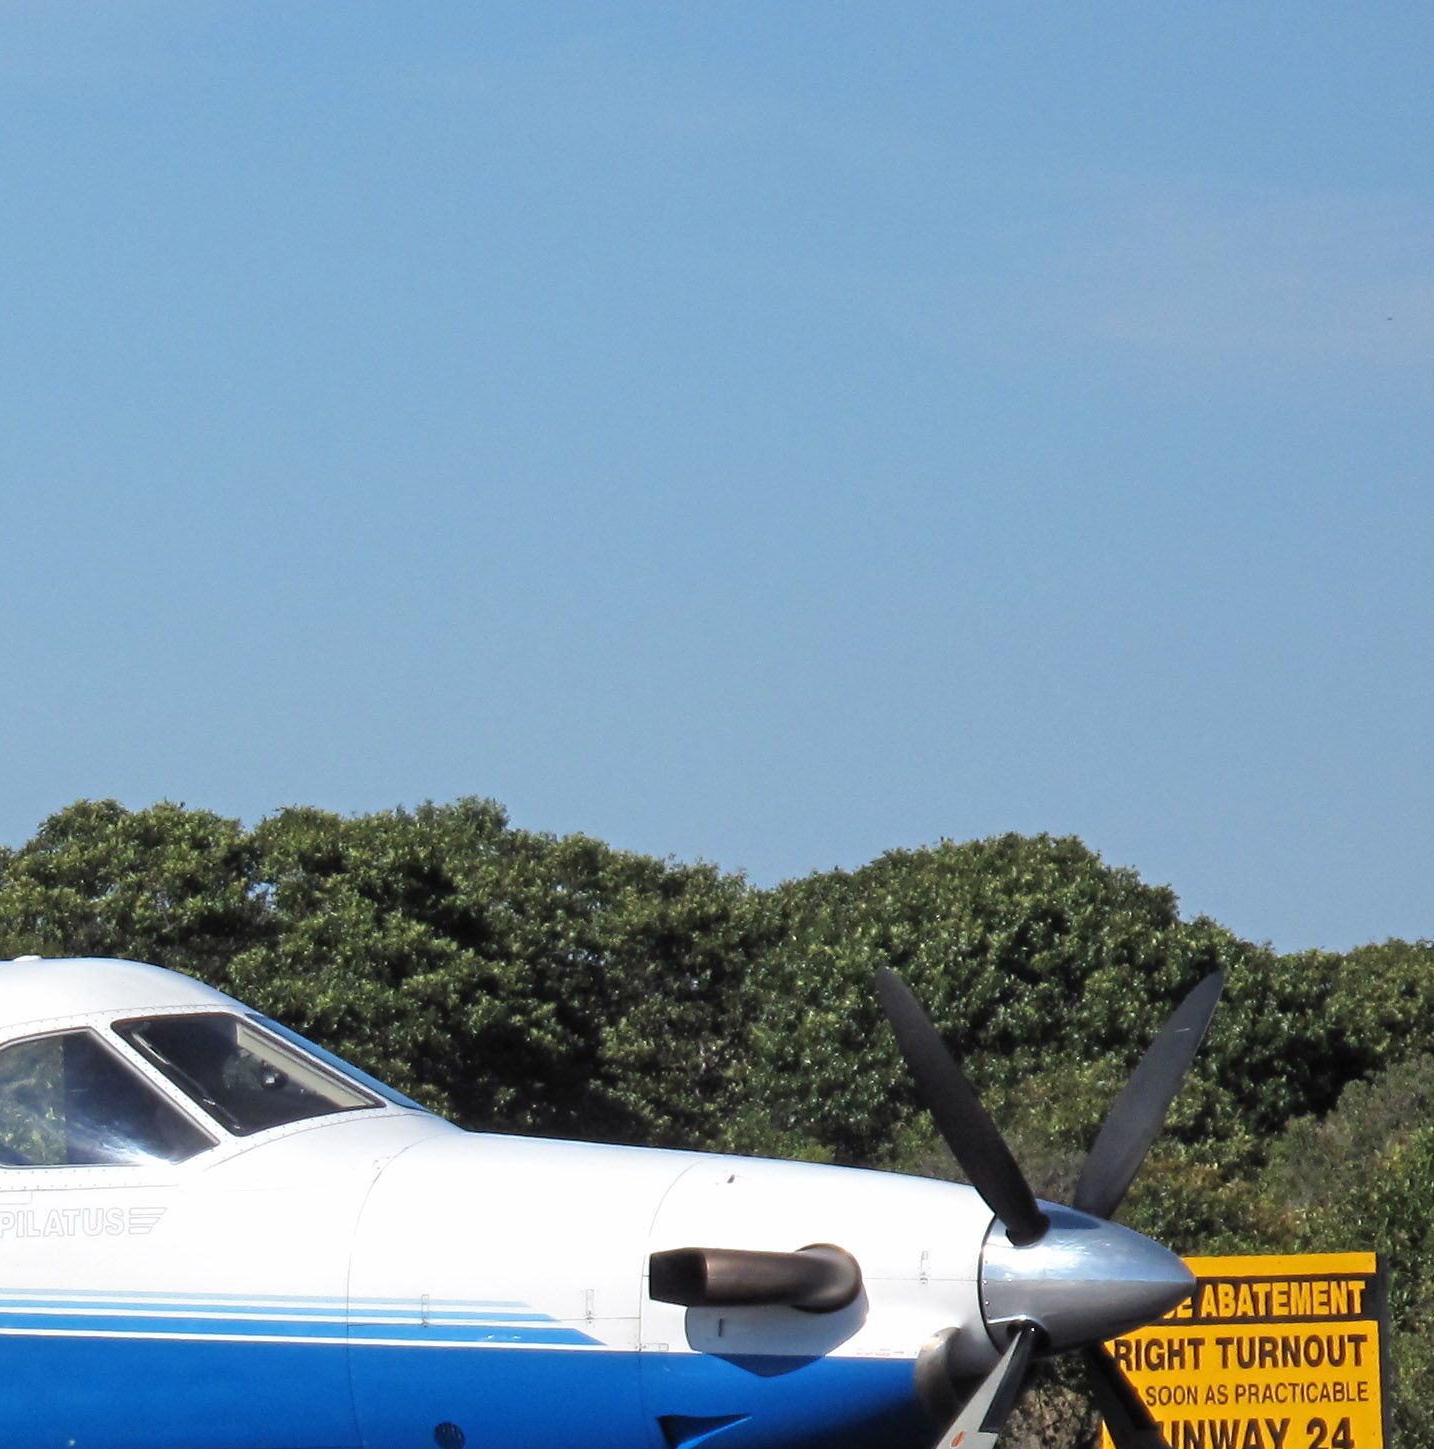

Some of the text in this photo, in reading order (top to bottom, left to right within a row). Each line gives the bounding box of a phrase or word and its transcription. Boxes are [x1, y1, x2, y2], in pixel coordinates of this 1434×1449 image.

[1200, 1280, 1366, 1318] ABATEMENT
[1114, 1334, 1368, 1371] RIGHT TURNOUT
[1145, 1384, 1198, 1406] SOON
[1205, 1383, 1229, 1405] AS
[1235, 1381, 1369, 1403] PRACTICABLE
